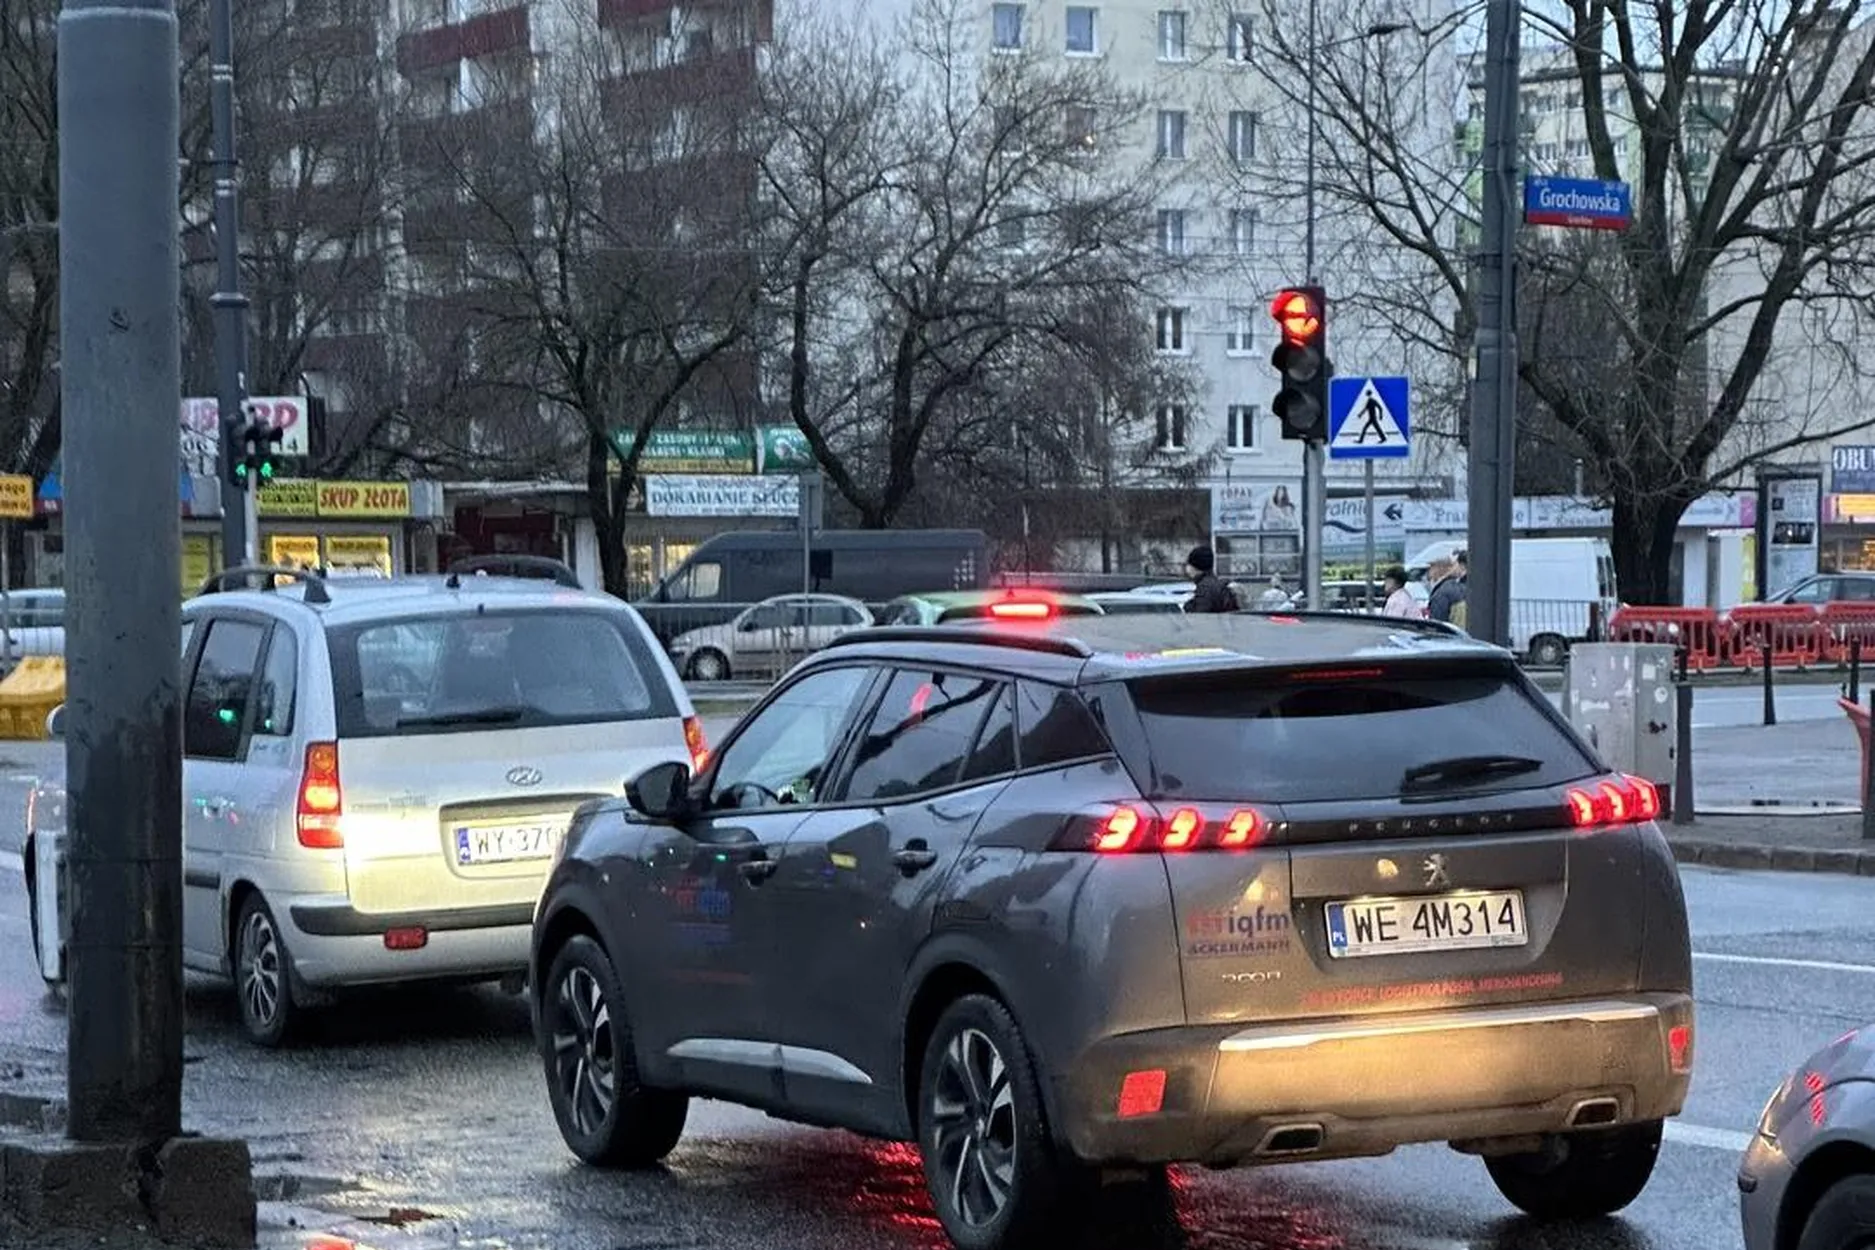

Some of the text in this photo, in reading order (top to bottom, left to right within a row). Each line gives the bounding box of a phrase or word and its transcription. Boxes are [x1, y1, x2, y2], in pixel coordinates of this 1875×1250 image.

[1540, 187, 1621, 212] Grochowska
[1833, 447, 1875, 471] OBU
[320, 486, 359, 509] SKUP
[363, 485, 407, 509] ZŁOTA
[1349, 813, 1514, 834] PEUGEOT
[476, 828, 504, 855] WY
[1228, 904, 1290, 938] iqfm
[1352, 898, 1516, 944] WE 4M314
[1188, 938, 1290, 956] ACKERMANN
[1333, 931, 1345, 942] PL
